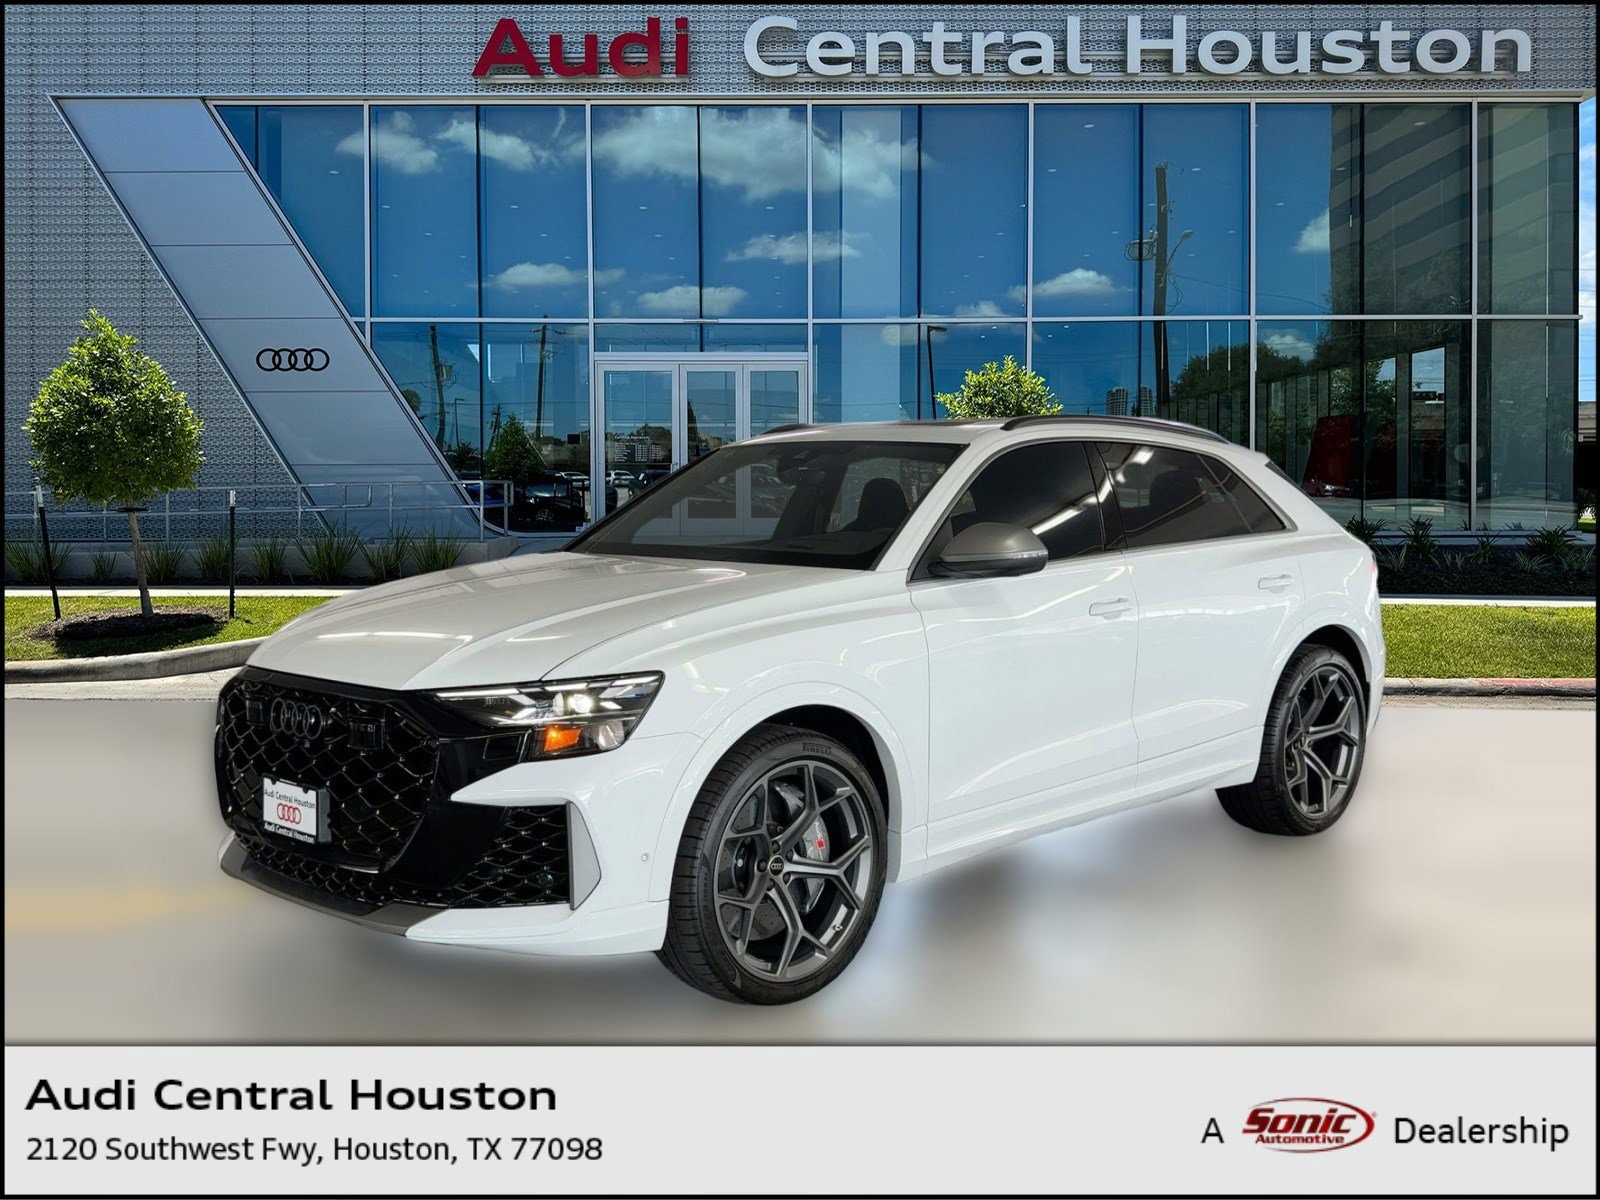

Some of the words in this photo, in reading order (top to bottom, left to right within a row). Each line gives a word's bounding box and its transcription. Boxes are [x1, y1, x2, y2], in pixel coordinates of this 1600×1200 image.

[472, 16, 689, 79] Audi
[743, 15, 1092, 78] Central
[1127, 15, 1532, 75] Houston
[264, 788, 275, 798] Audi
[275, 791, 293, 803] Central
[294, 795, 316, 809] Houston
[264, 821, 275, 832] Audi
[275, 824, 293, 837] Central
[293, 829, 315, 844] Houston
